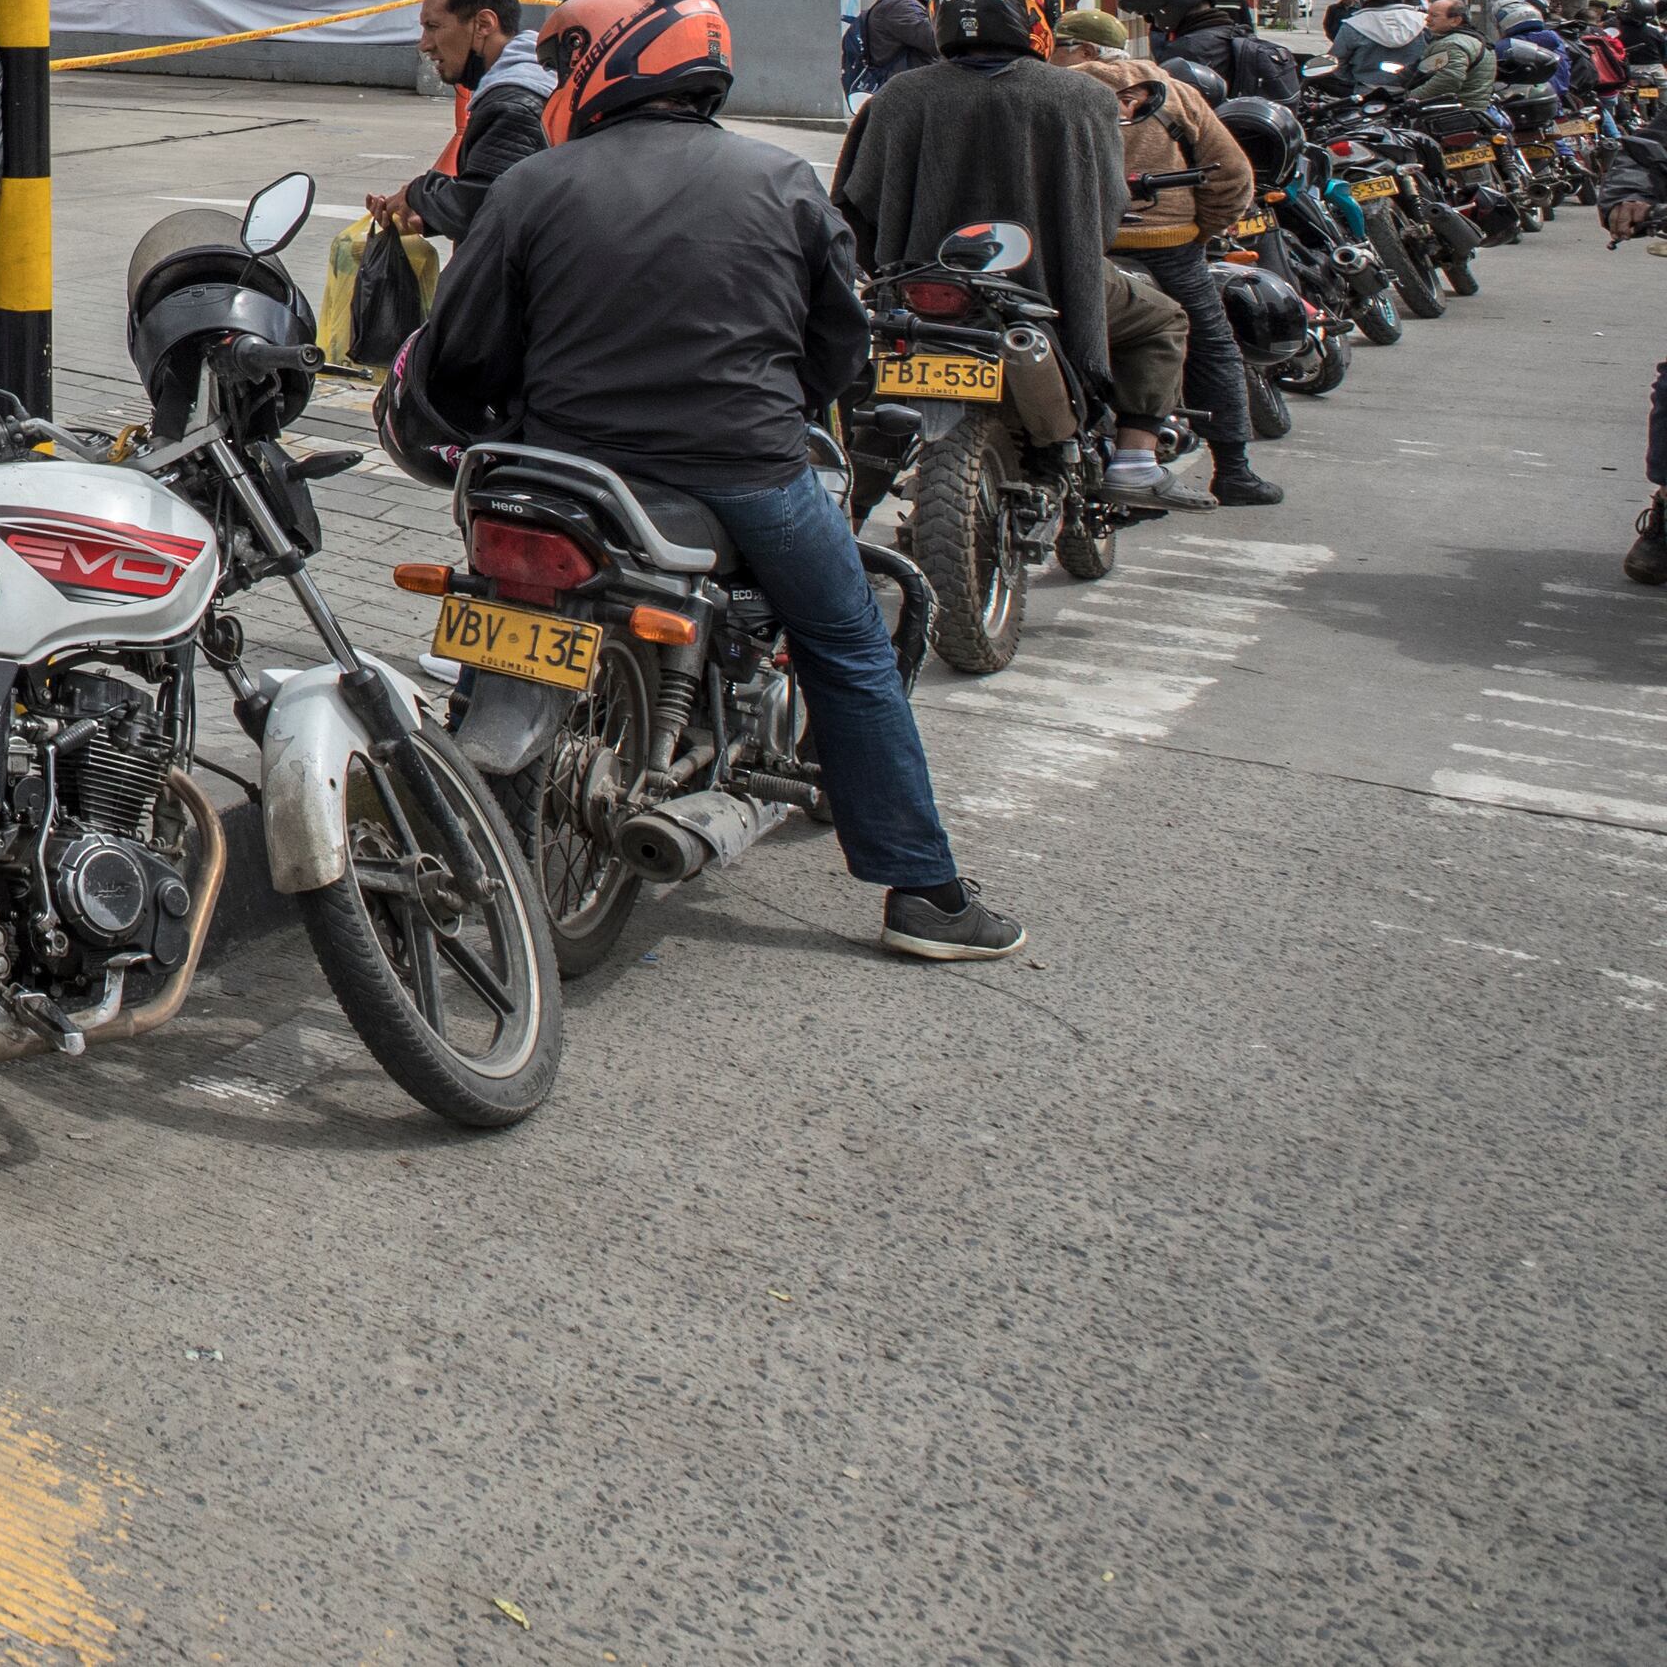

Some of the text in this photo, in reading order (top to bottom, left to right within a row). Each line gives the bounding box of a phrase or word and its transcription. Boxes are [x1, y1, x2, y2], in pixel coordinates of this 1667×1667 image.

[881, 362, 996, 388] FBI 53G
[491, 500, 523, 514] Hero
[6, 534, 175, 585] EVO
[732, 590, 752, 601] ECO
[446, 605, 593, 674] VBV 13E
[481, 655, 535, 675] COLOMBIA
